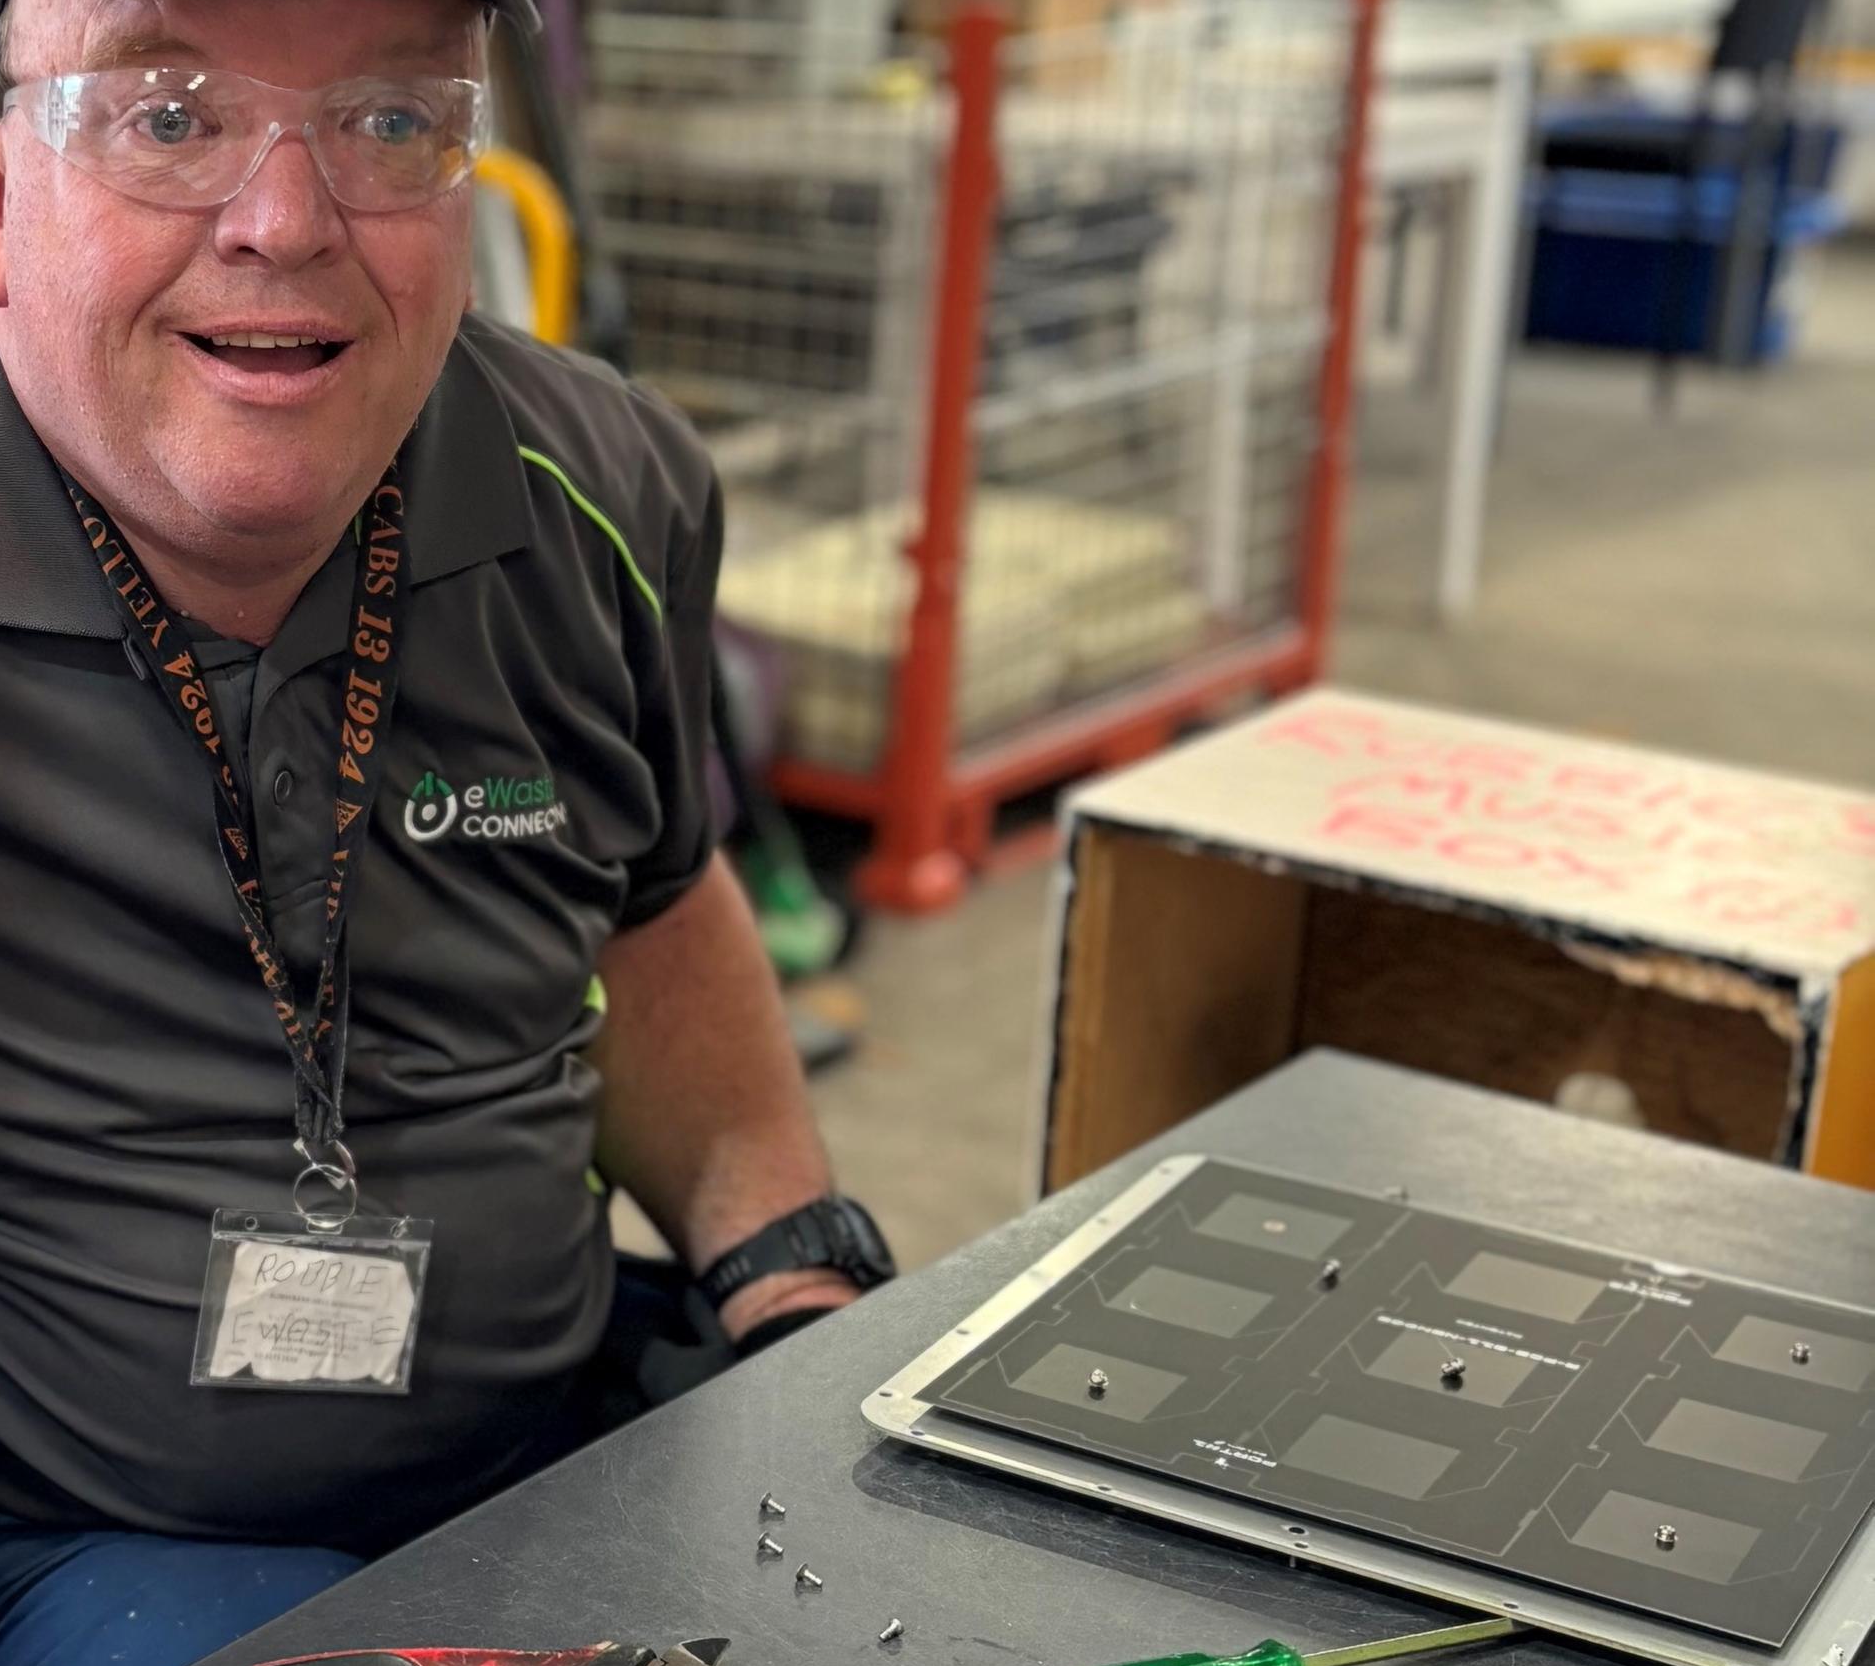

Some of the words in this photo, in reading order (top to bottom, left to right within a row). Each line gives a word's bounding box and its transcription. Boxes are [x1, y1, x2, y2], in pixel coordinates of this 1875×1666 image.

[364, 484, 405, 598] CABS
[354, 604, 393, 664] 13
[339, 668, 381, 784] 1924
[254, 1253, 389, 1294] ROBBIE
